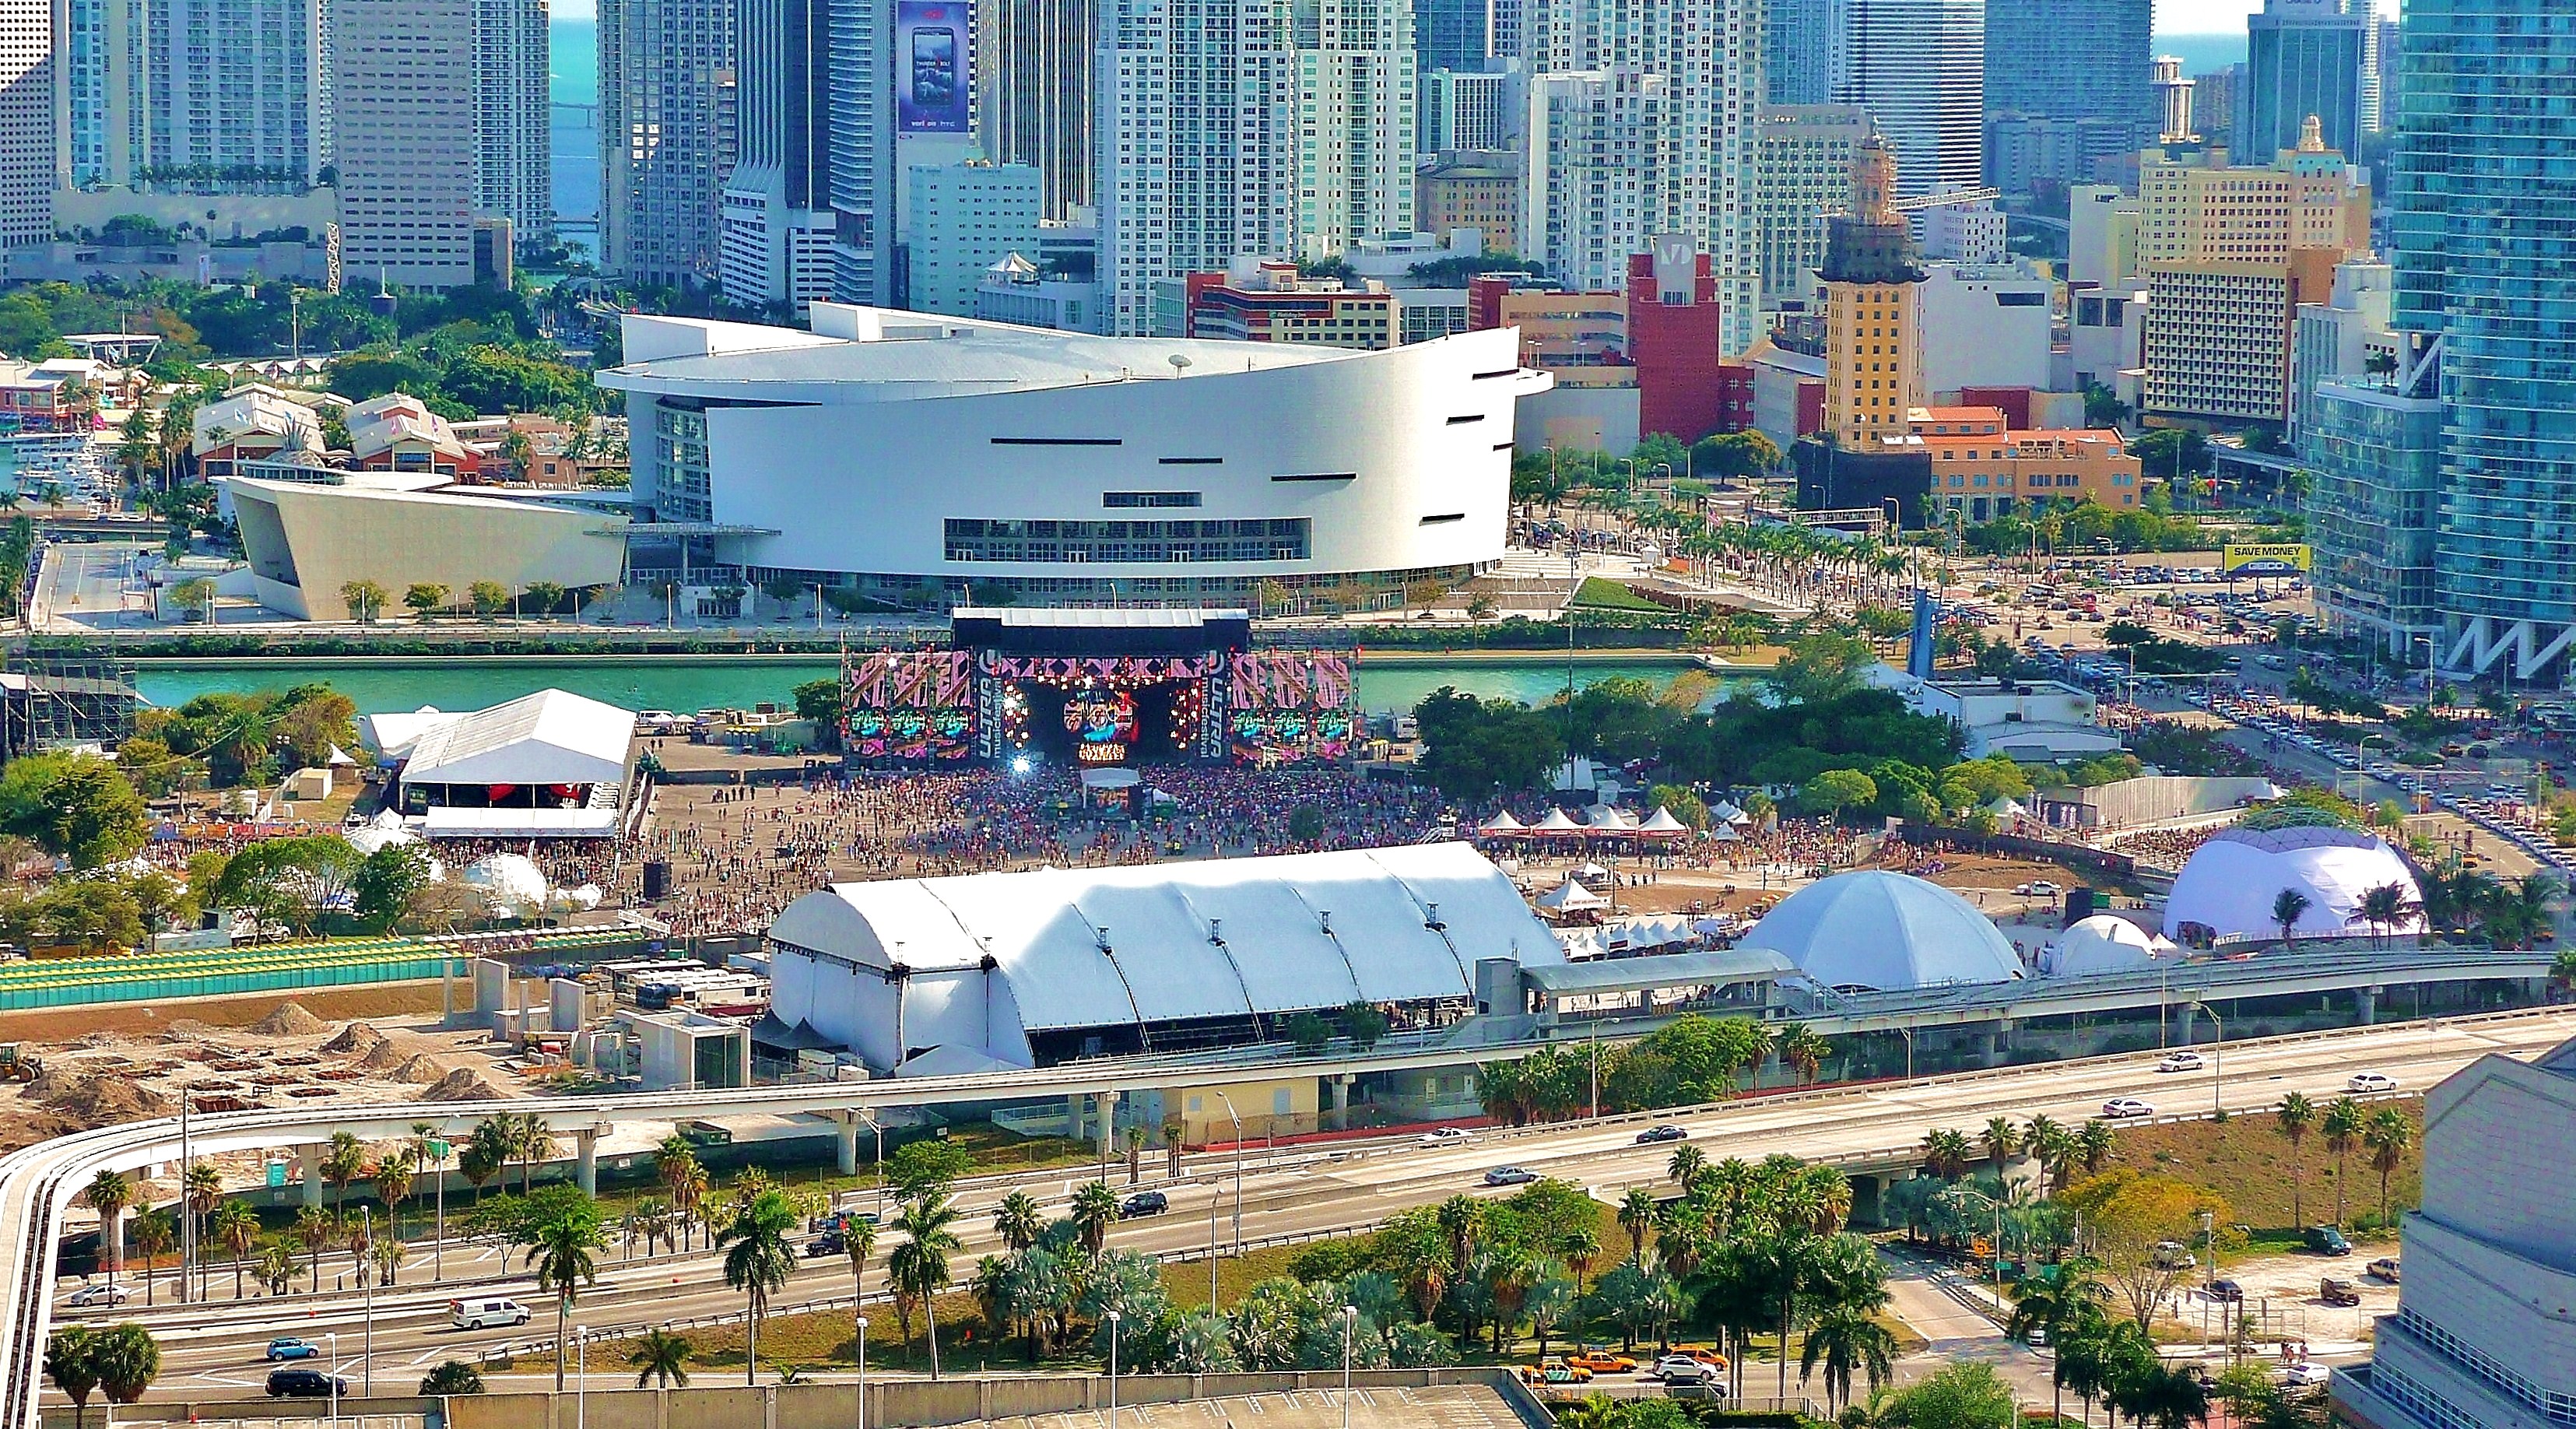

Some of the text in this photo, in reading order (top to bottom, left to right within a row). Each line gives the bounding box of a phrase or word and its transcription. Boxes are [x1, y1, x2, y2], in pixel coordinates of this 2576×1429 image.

[2234, 547, 2301, 556] SAVE MONEY
[979, 677, 994, 759] ULTRA
[992, 677, 1002, 759] musicfestival
[1200, 676, 1210, 758] musicfestival
[1209, 676, 1223, 758] ULTRA
